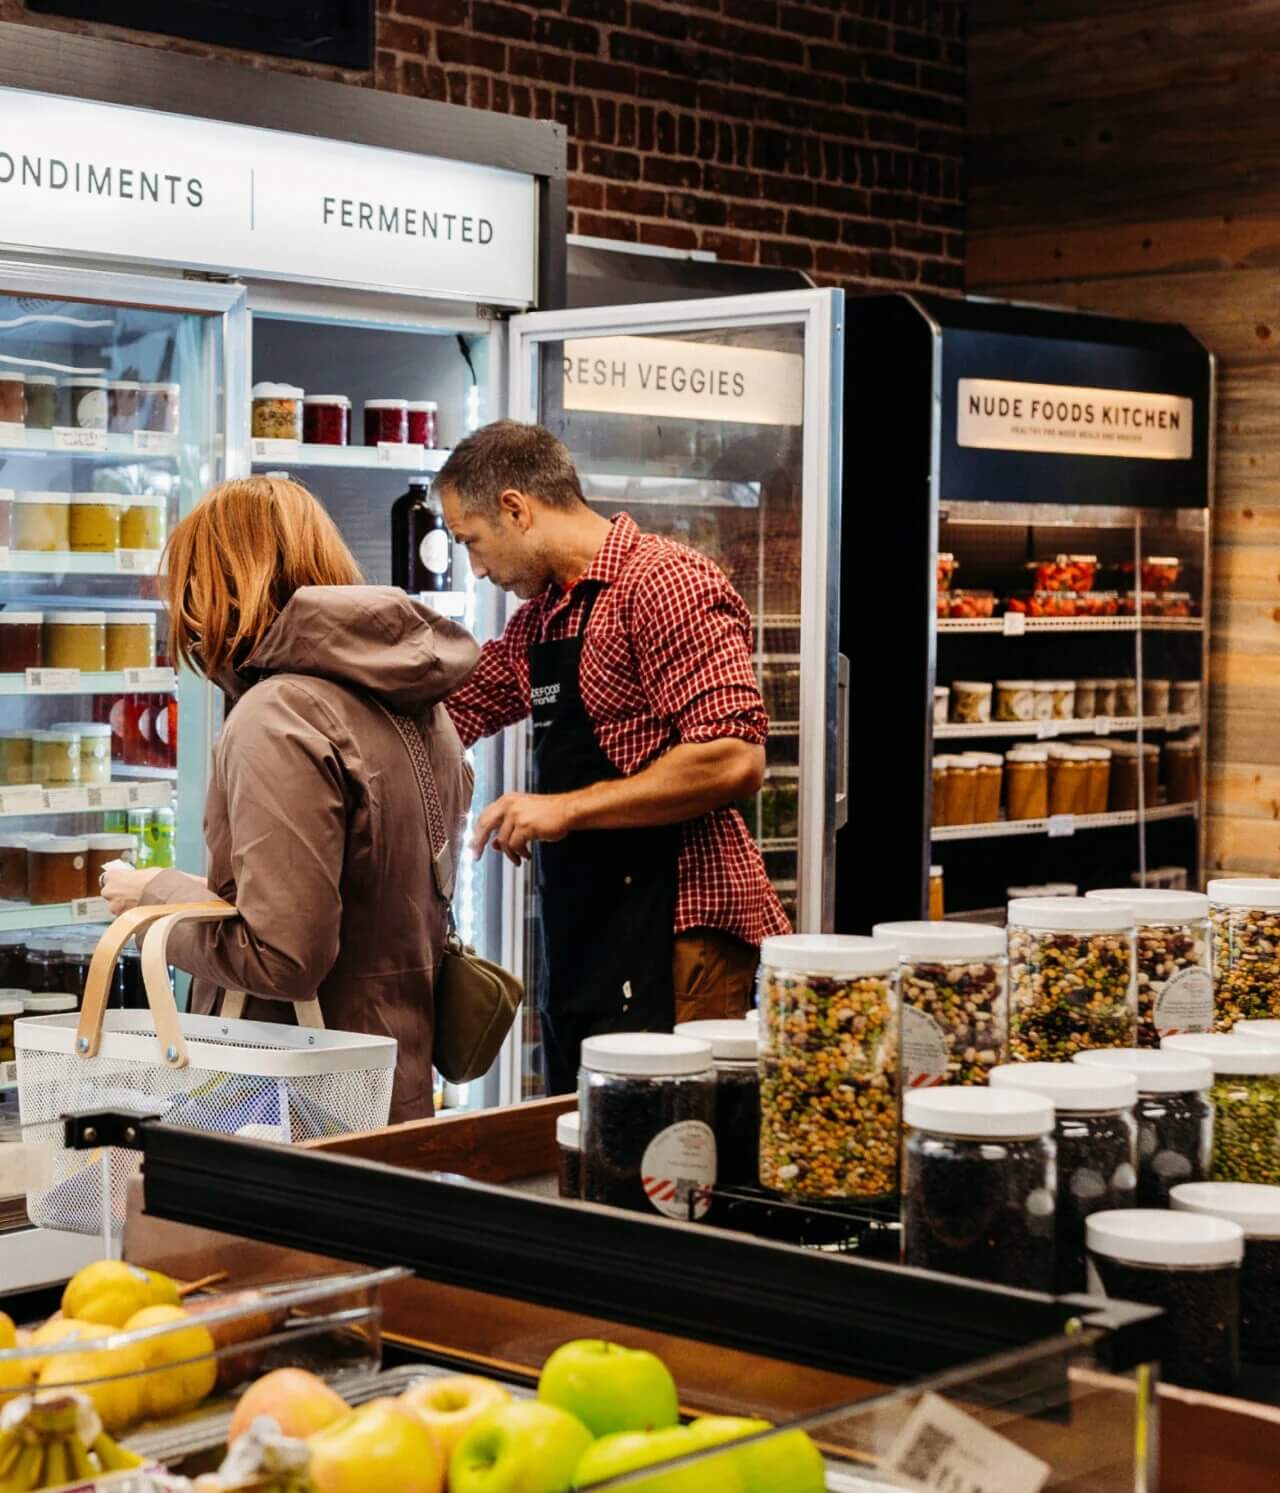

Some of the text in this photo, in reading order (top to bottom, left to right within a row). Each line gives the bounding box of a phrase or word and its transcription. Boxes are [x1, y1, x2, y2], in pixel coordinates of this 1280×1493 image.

[323, 196, 494, 246] FERMENTED
[563, 355, 745, 398] RESH VEGGIES
[969, 395, 1180, 430] NUDE FOODS KITCHEN
